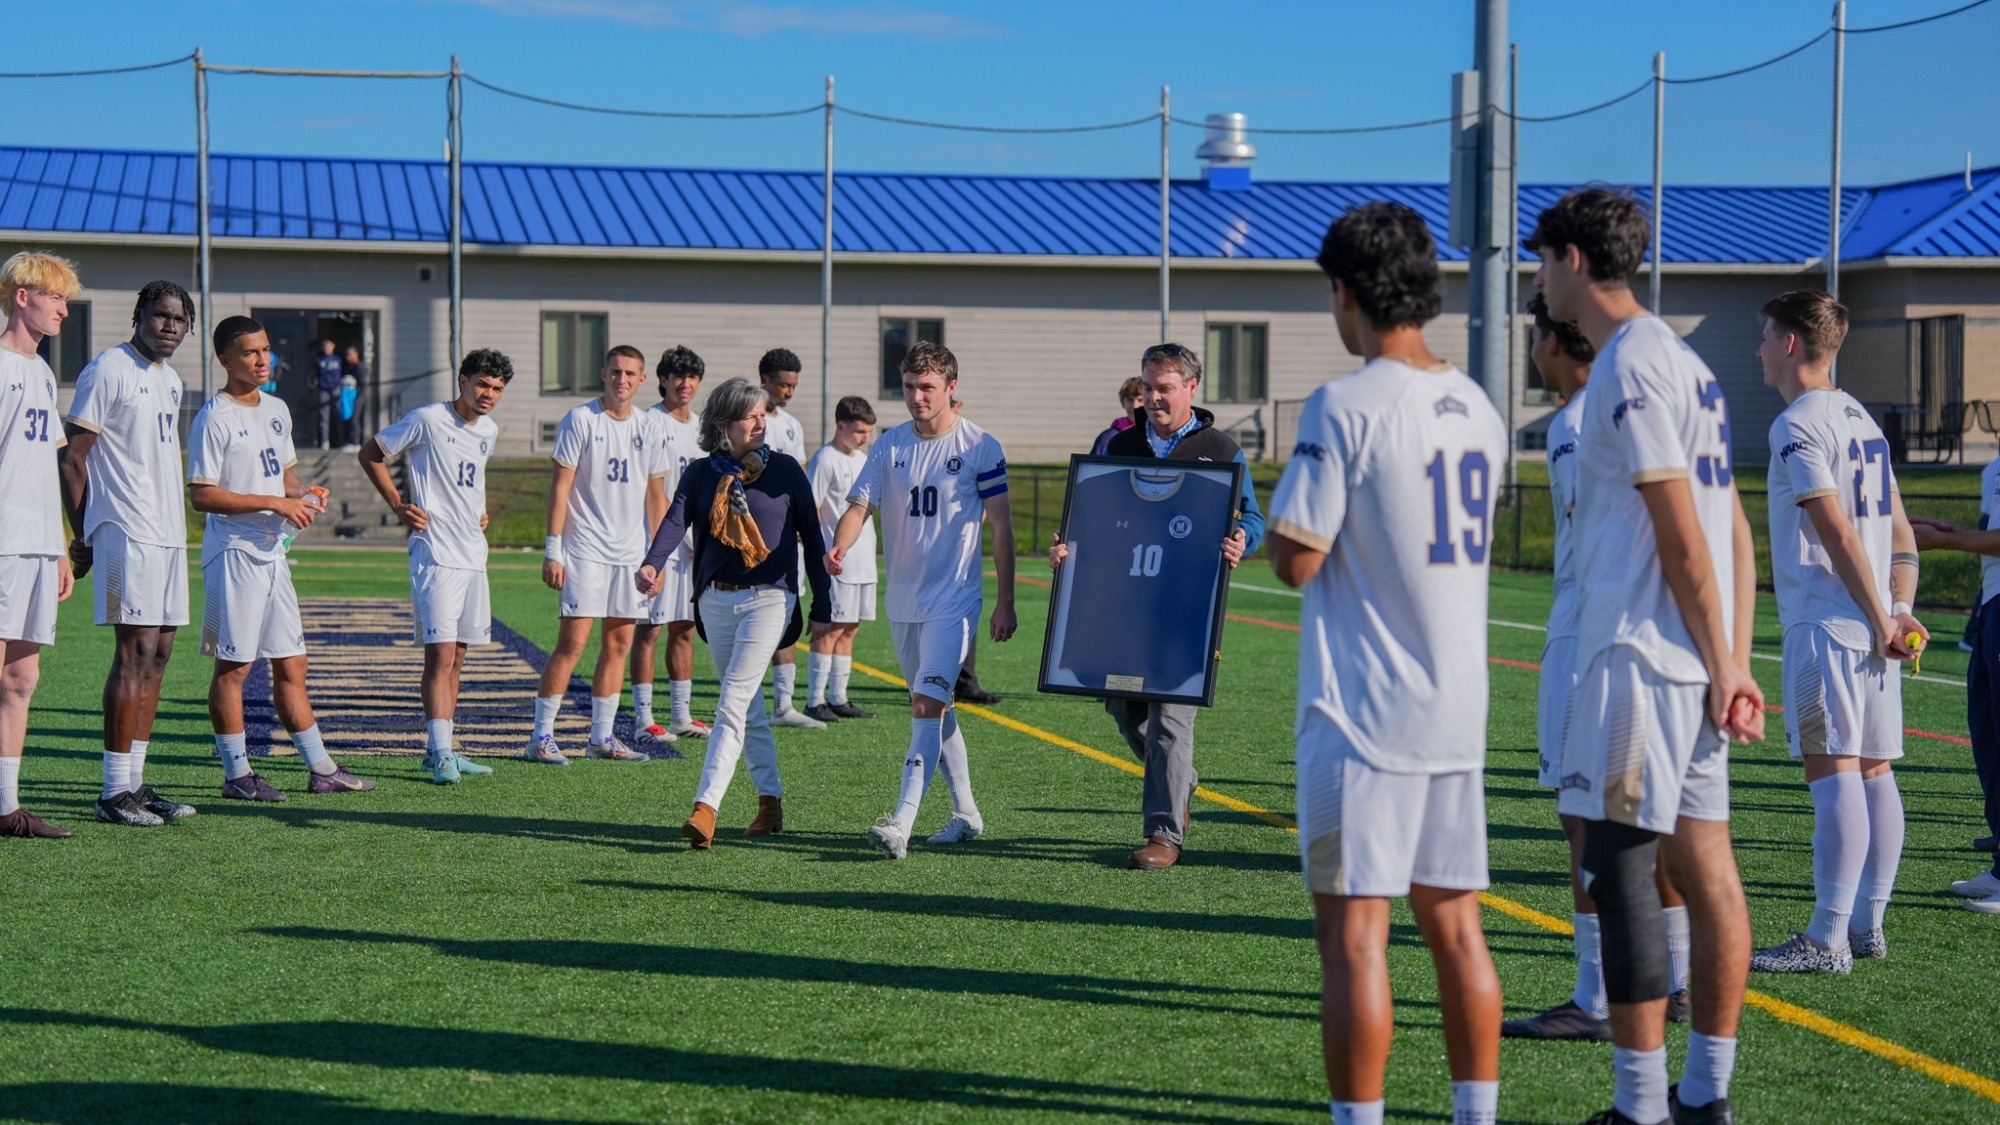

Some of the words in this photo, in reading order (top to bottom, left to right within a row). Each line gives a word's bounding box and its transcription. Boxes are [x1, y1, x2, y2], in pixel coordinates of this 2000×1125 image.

[24, 408, 49, 442] 37
[260, 447, 281, 477] 16
[1780, 440, 1808, 464] MAAC
[457, 461, 476, 487] 13
[607, 457, 628, 483] 31
[1848, 438, 1892, 517] 27
[910, 485, 938, 517] 10
[1426, 449, 1490, 566] 19
[1129, 544, 1163, 577] 10
